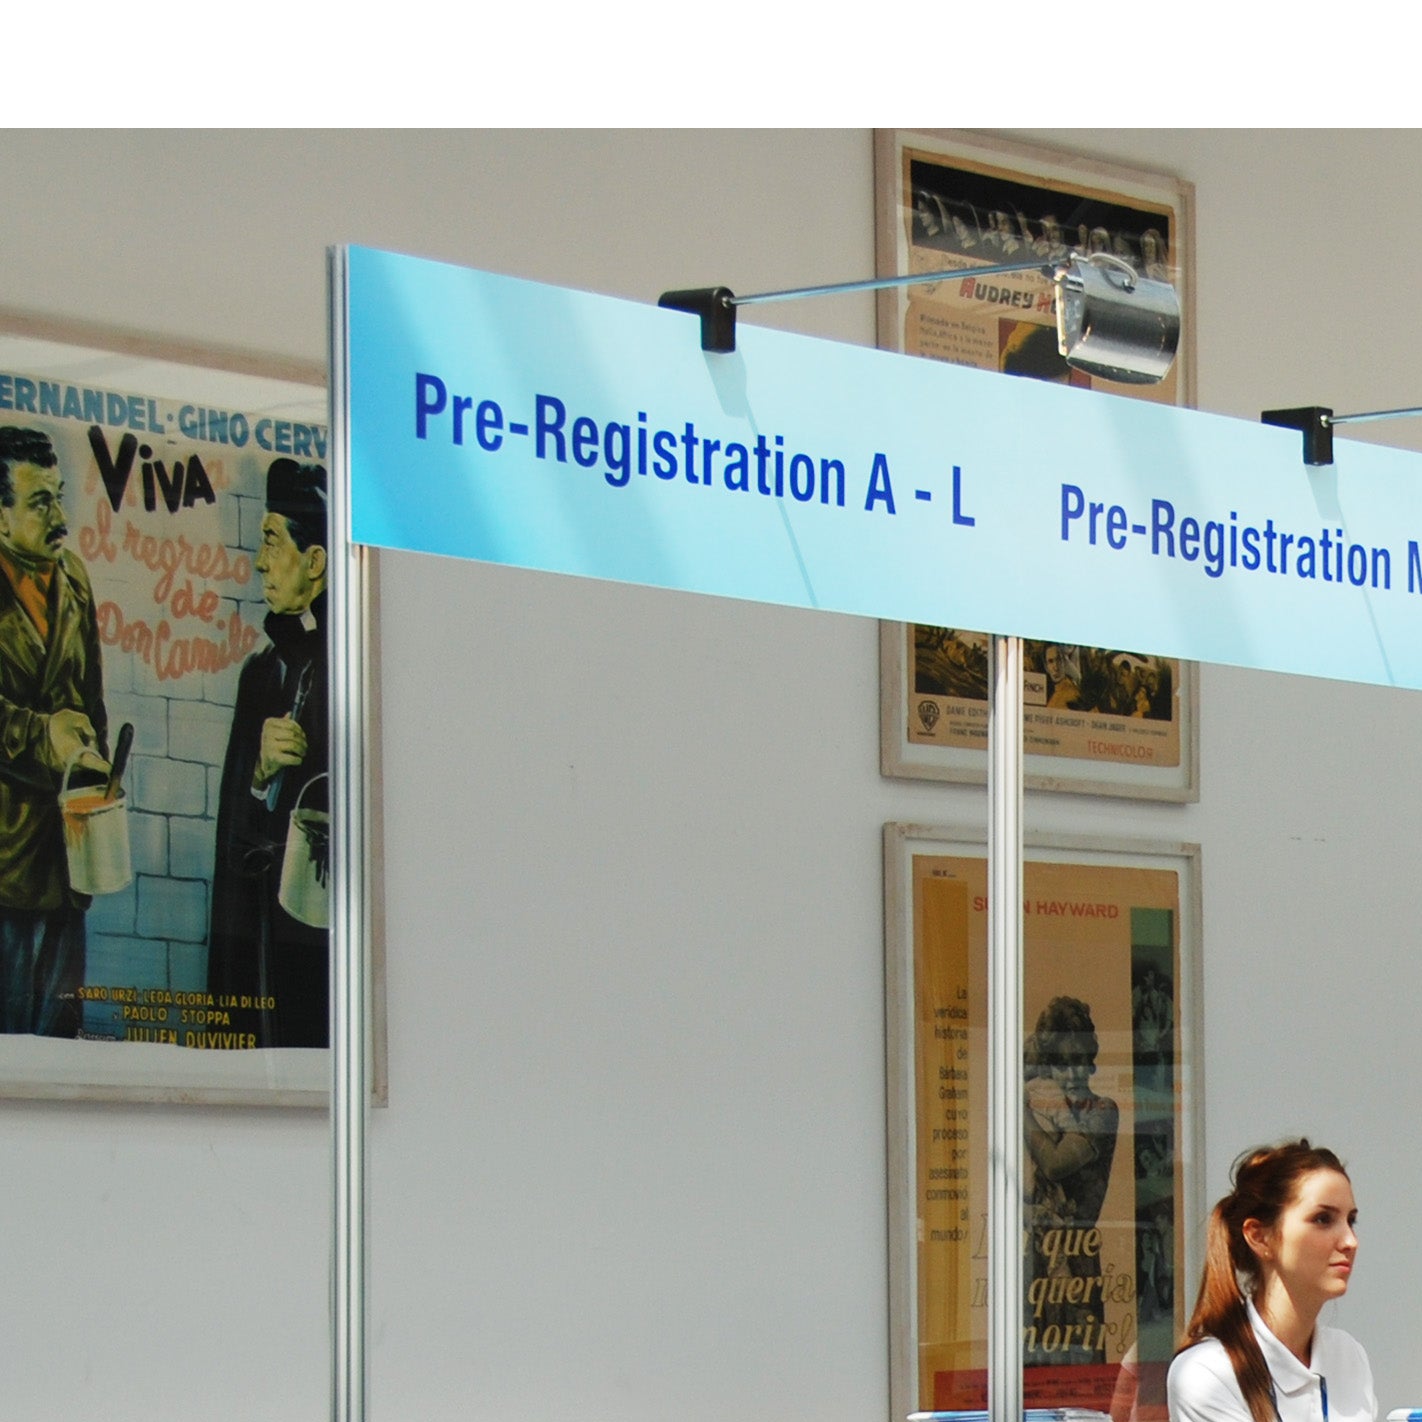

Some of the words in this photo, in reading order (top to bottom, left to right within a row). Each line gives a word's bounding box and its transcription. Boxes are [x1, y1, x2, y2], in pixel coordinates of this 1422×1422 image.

[959, 277, 1035, 309] AUDREY
[179, 405, 250, 447] GINO
[415, 372, 846, 508] Pre-Registration
[864, 453, 896, 515] A
[915, 490, 932, 501] -
[952, 465, 976, 527] L
[78, 498, 117, 563] el
[1061, 483, 1391, 590] Pre-Registration
[123, 520, 251, 604] regreso
[171, 579, 219, 622] de
[97, 601, 153, 665] Don
[154, 611, 260, 682] Camilo
[1036, 901, 1119, 919] HAYWARD
[78, 986, 108, 1000] SARO
[143, 990, 172, 1004] LEDA
[175, 993, 214, 1006] GLORIA
[219, 995, 238, 1009] LIA
[241, 996, 251, 1009] DI
[255, 997, 275, 1010] LEO
[123, 1005, 167, 1022] PAOLO
[181, 1009, 230, 1026] STOPPA
[125, 1027, 177, 1044] JULIEN
[185, 1031, 257, 1049] DUVIVIER
[1042, 1227, 1101, 1268] que
